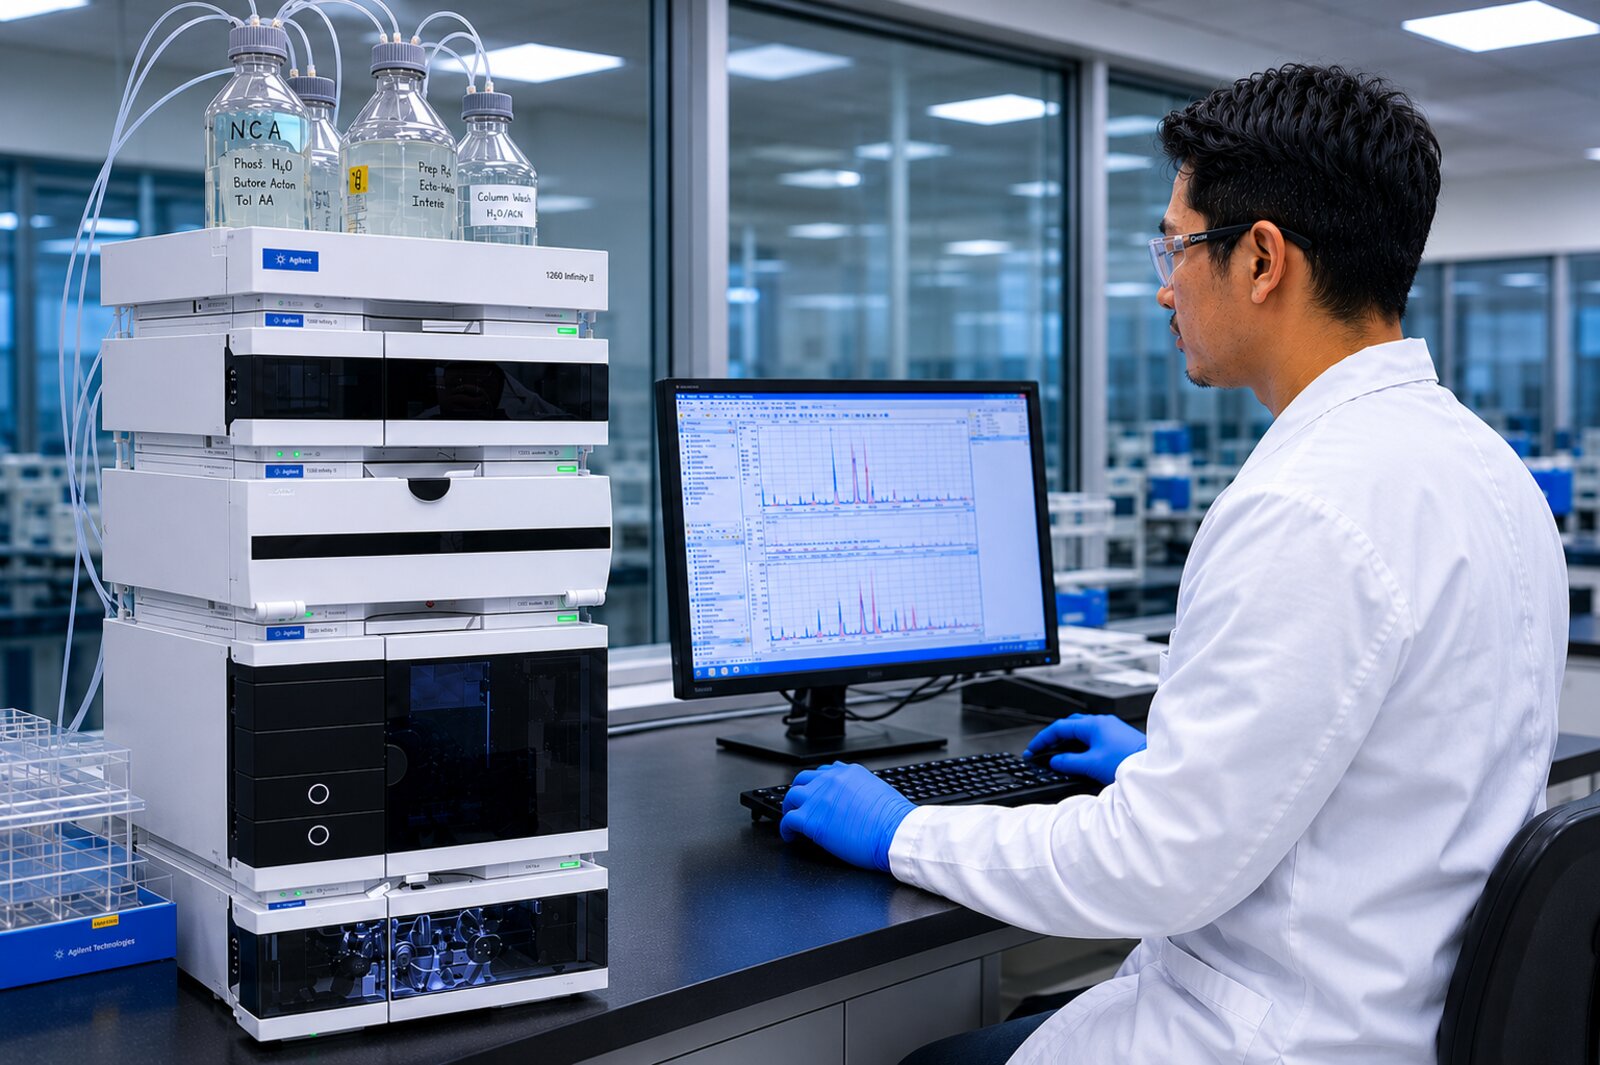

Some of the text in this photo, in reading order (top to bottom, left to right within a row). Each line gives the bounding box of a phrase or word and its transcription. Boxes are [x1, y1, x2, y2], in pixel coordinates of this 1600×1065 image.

[418, 161, 438, 178] Prep
[259, 194, 274, 206] AA
[477, 191, 509, 202] Column
[289, 256, 312, 265] Agilent
[546, 271, 563, 280] 1260
[564, 272, 588, 283] Infinity
[67, 938, 135, 957] Agilent Technologies
